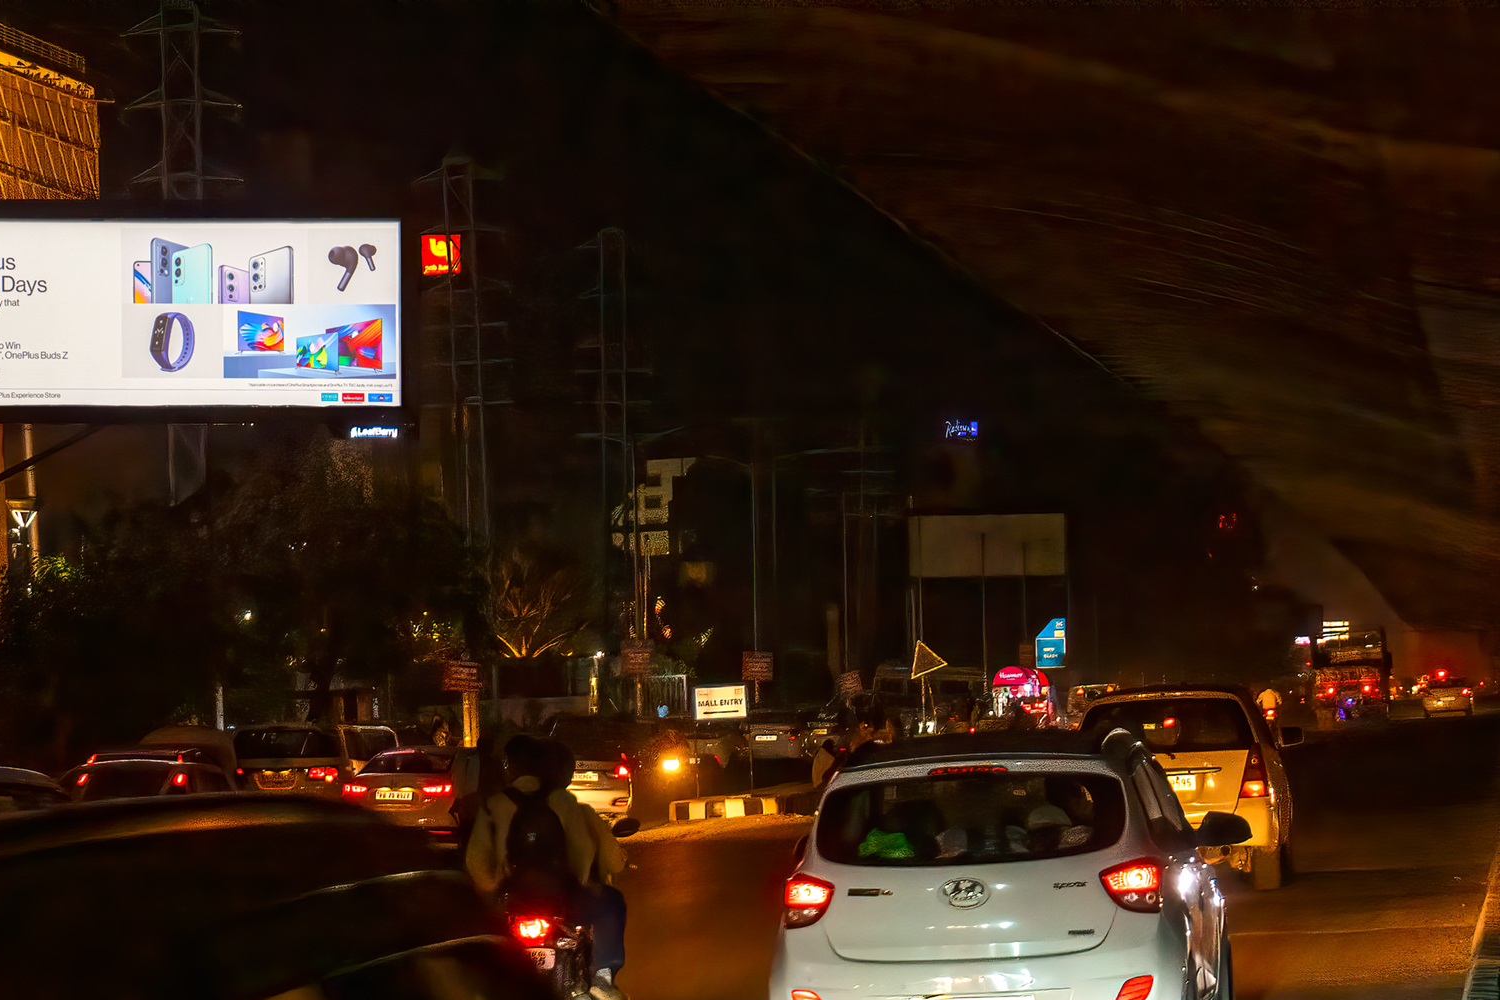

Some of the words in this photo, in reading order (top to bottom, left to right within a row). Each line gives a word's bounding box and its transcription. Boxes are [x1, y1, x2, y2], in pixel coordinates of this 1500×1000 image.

[1, 275, 48, 296] Days
[4, 298, 20, 307] that
[5, 341, 21, 350] Win
[4, 351, 39, 360] OnePlus
[40, 351, 61, 360] Buds
[62, 351, 69, 360] Z
[11, 392, 44, 400] Experience
[698, 699, 718, 707] MALL
[720, 698, 743, 706] ENTRY
